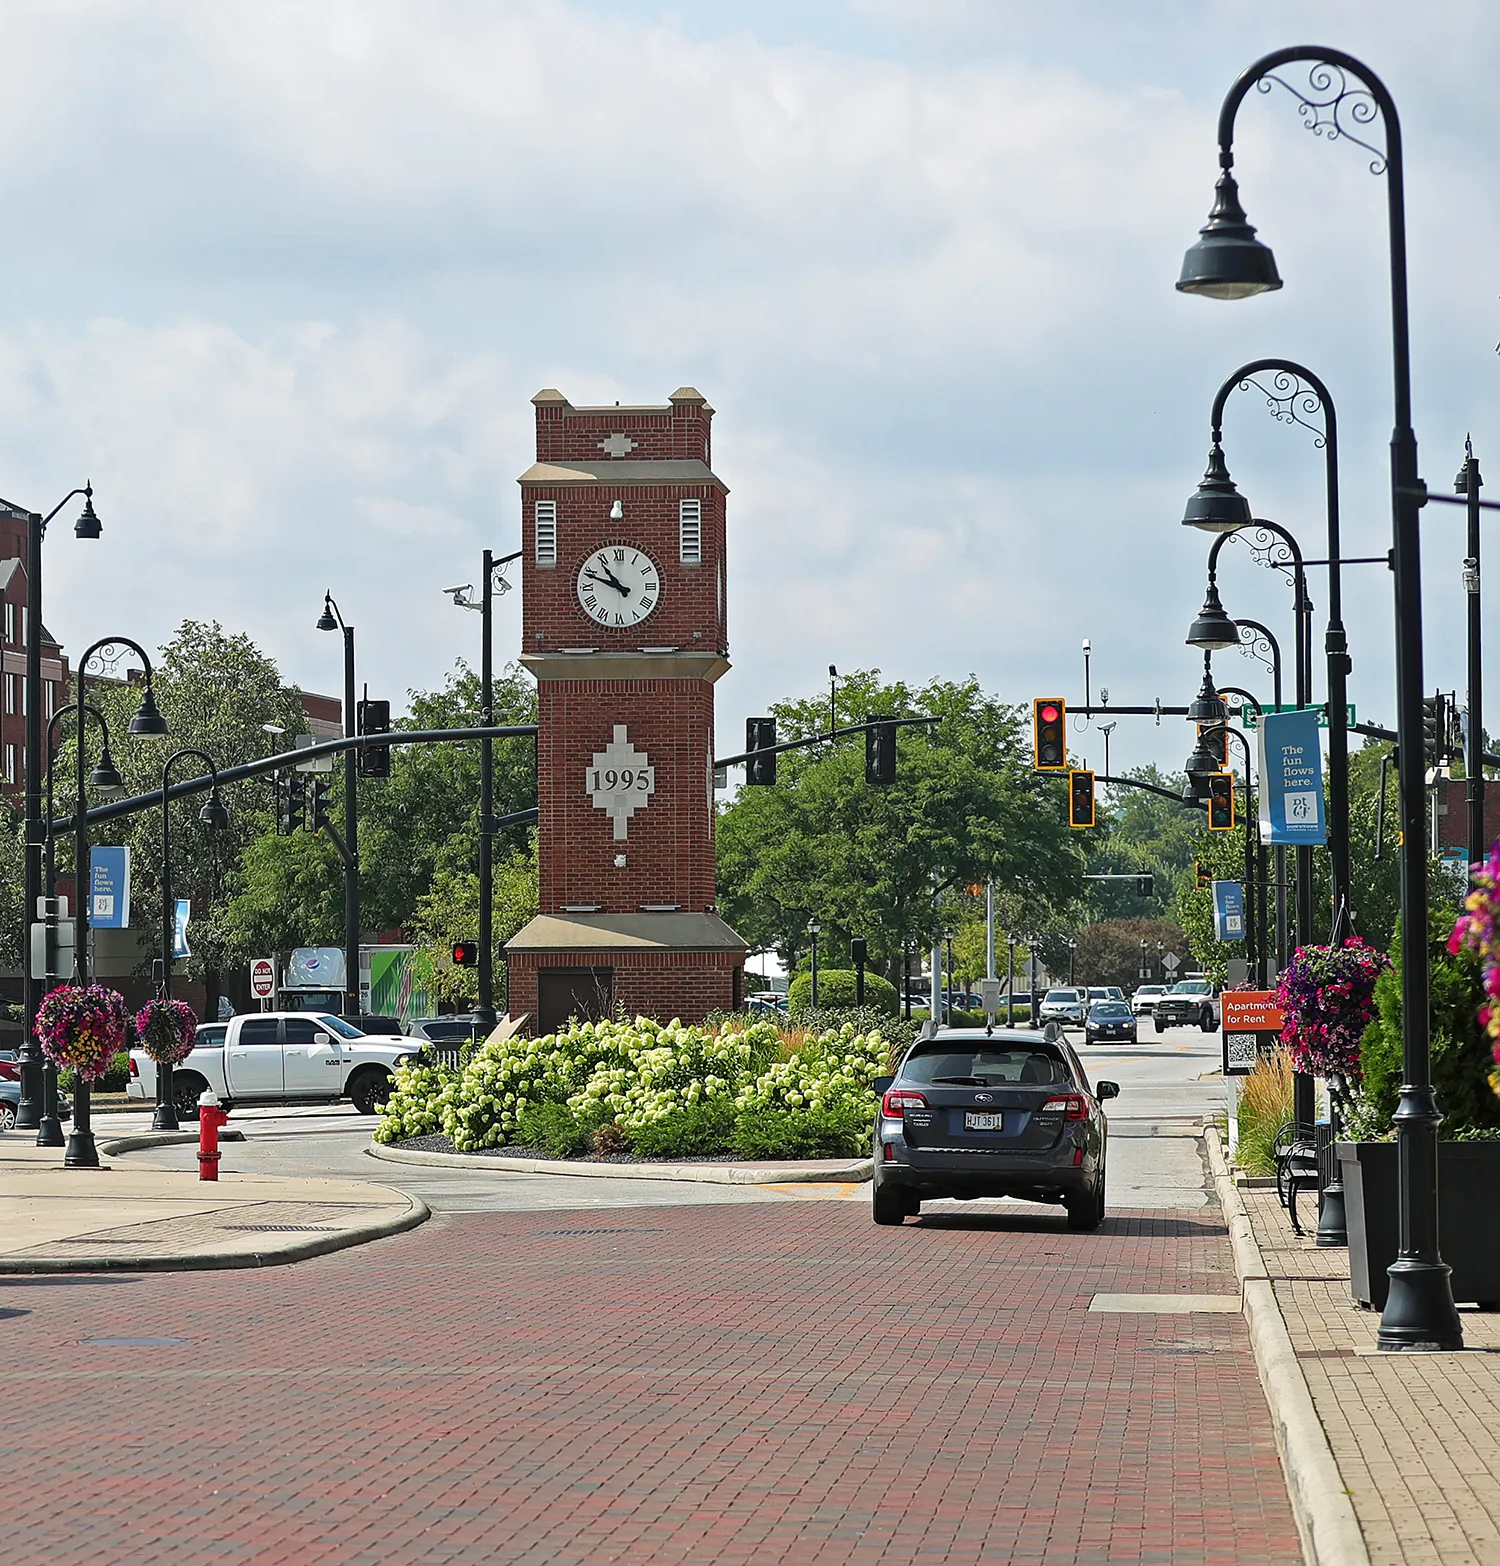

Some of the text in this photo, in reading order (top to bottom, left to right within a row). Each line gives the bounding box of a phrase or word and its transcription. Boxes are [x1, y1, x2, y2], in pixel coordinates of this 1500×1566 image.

[1281, 746, 1304, 755] The
[1282, 757, 1303, 767] fun
[1283, 767, 1315, 777] flows
[591, 769, 650, 791] 1995
[1284, 777, 1313, 788] here.
[1227, 1015, 1266, 1024] for Rent
[966, 1116, 981, 1126] HJT
